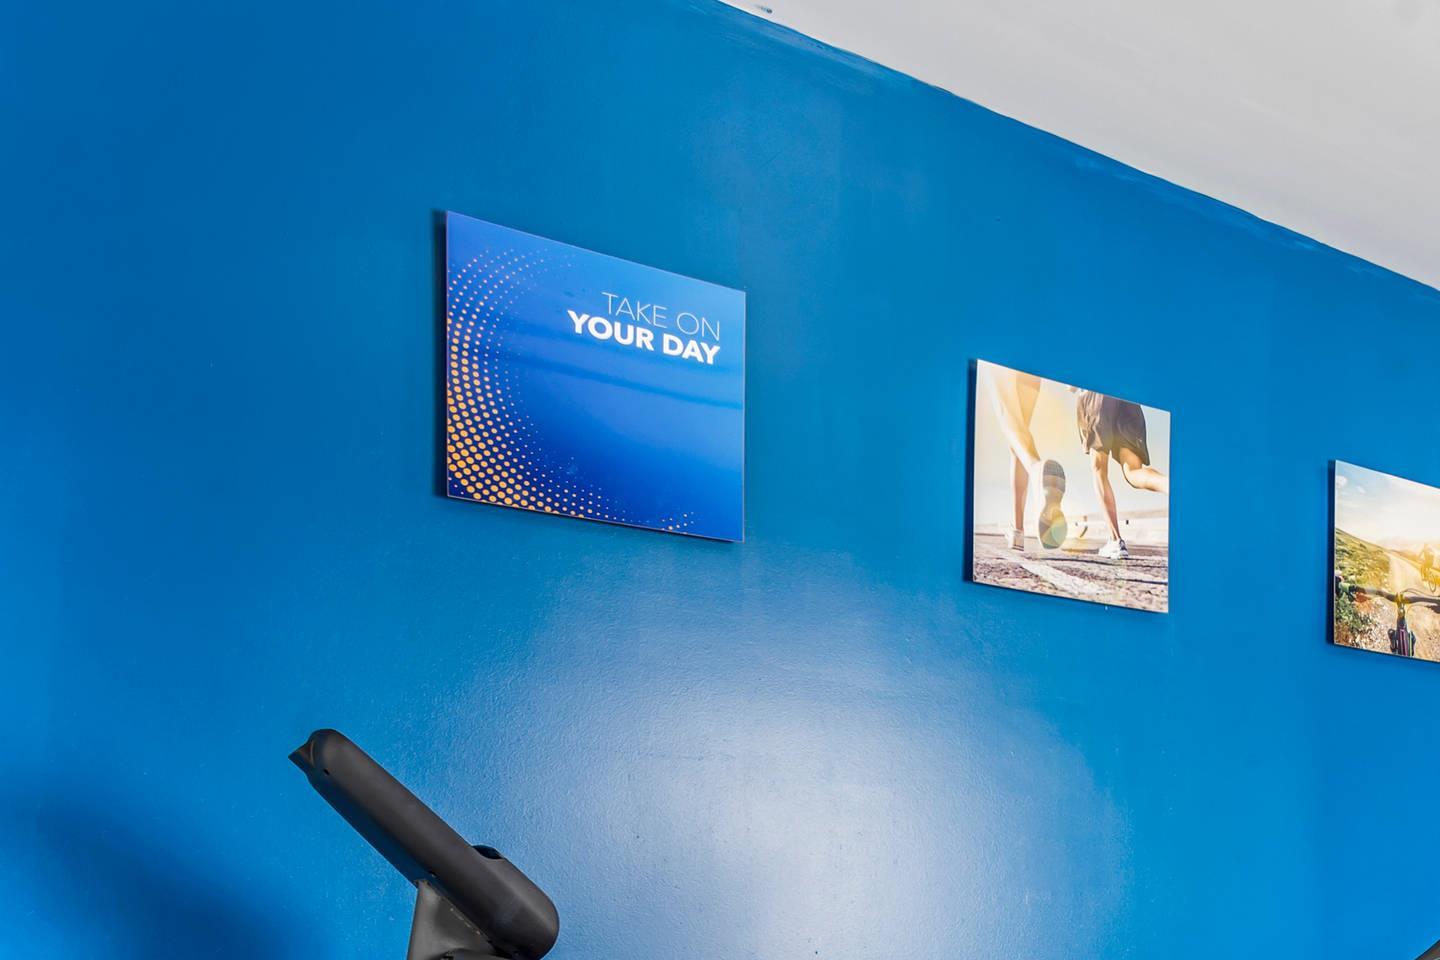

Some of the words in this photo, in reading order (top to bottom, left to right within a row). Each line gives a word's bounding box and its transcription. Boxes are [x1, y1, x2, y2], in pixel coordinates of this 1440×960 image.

[567, 310, 655, 352] YOUR
[662, 332, 721, 366] DAY
[601, 292, 669, 330] TAKE
[676, 311, 721, 341] ON
